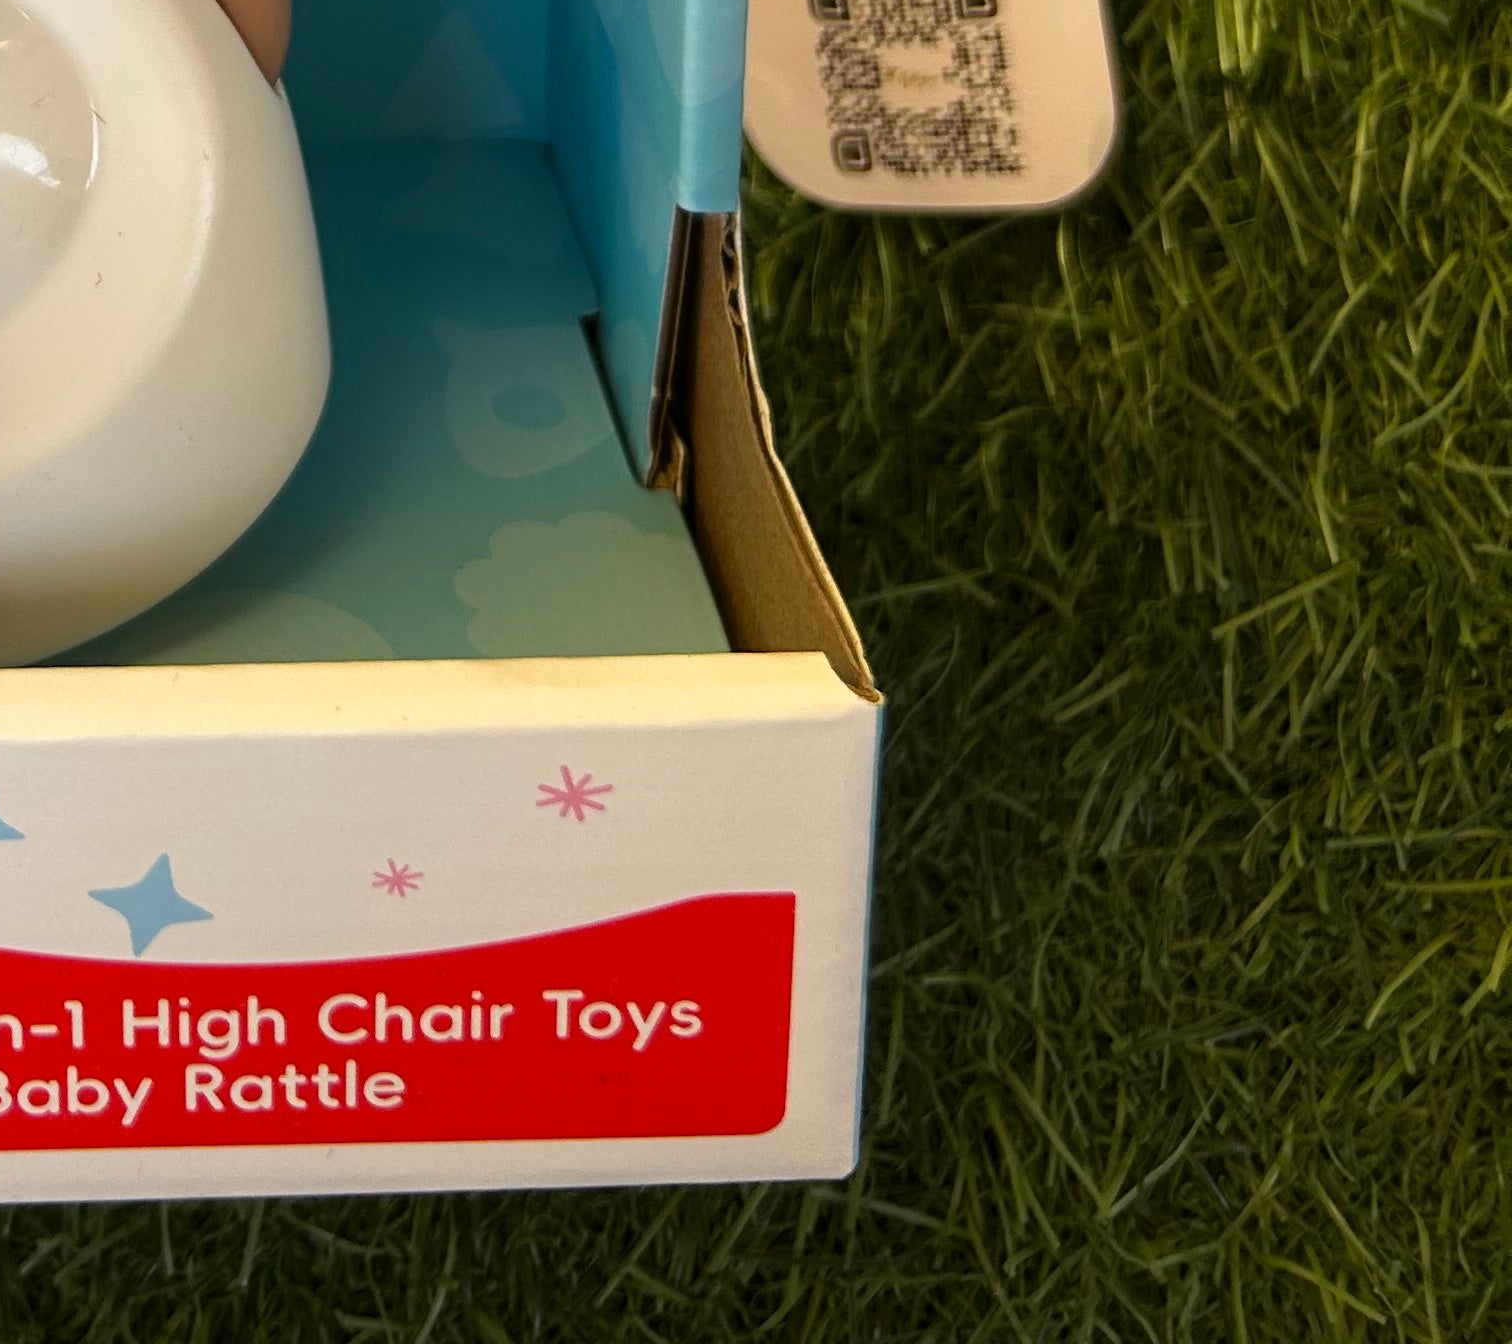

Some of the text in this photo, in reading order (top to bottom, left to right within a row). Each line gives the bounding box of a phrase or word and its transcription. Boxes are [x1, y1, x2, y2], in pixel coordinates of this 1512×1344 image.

[122, 995, 288, 1059] High
[317, 989, 515, 1045] Chair
[542, 986, 704, 1052] Toys
[184, 1060, 407, 1113] Rattle
